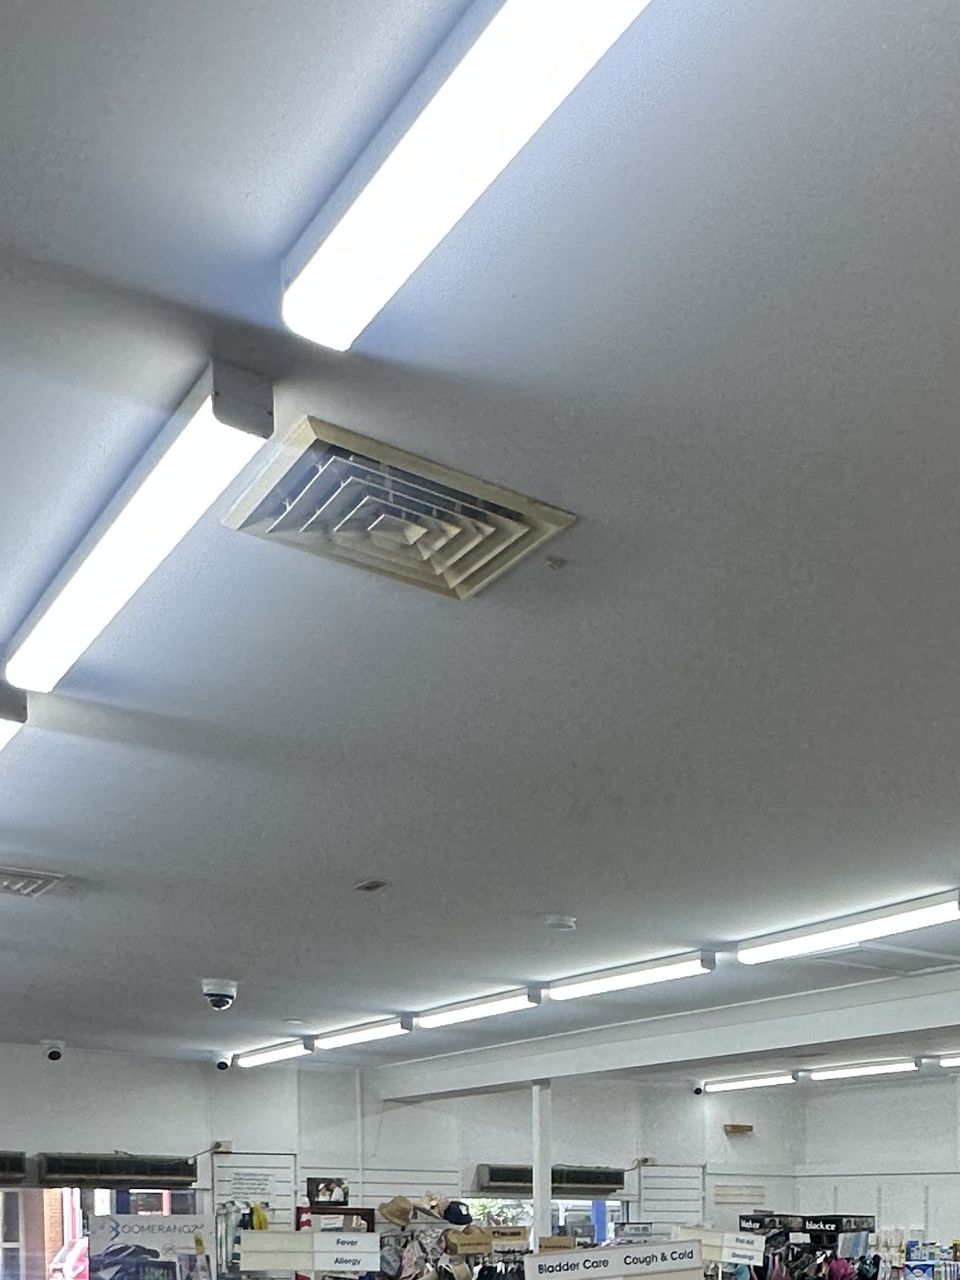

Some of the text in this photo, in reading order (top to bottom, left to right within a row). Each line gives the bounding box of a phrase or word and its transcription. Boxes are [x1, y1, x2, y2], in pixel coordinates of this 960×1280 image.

[336, 1238, 358, 1246] Fever
[334, 1257, 361, 1266] Allergy
[623, 1249, 694, 1266] Cough & Cold
[538, 1258, 610, 1274] Bladder Care
